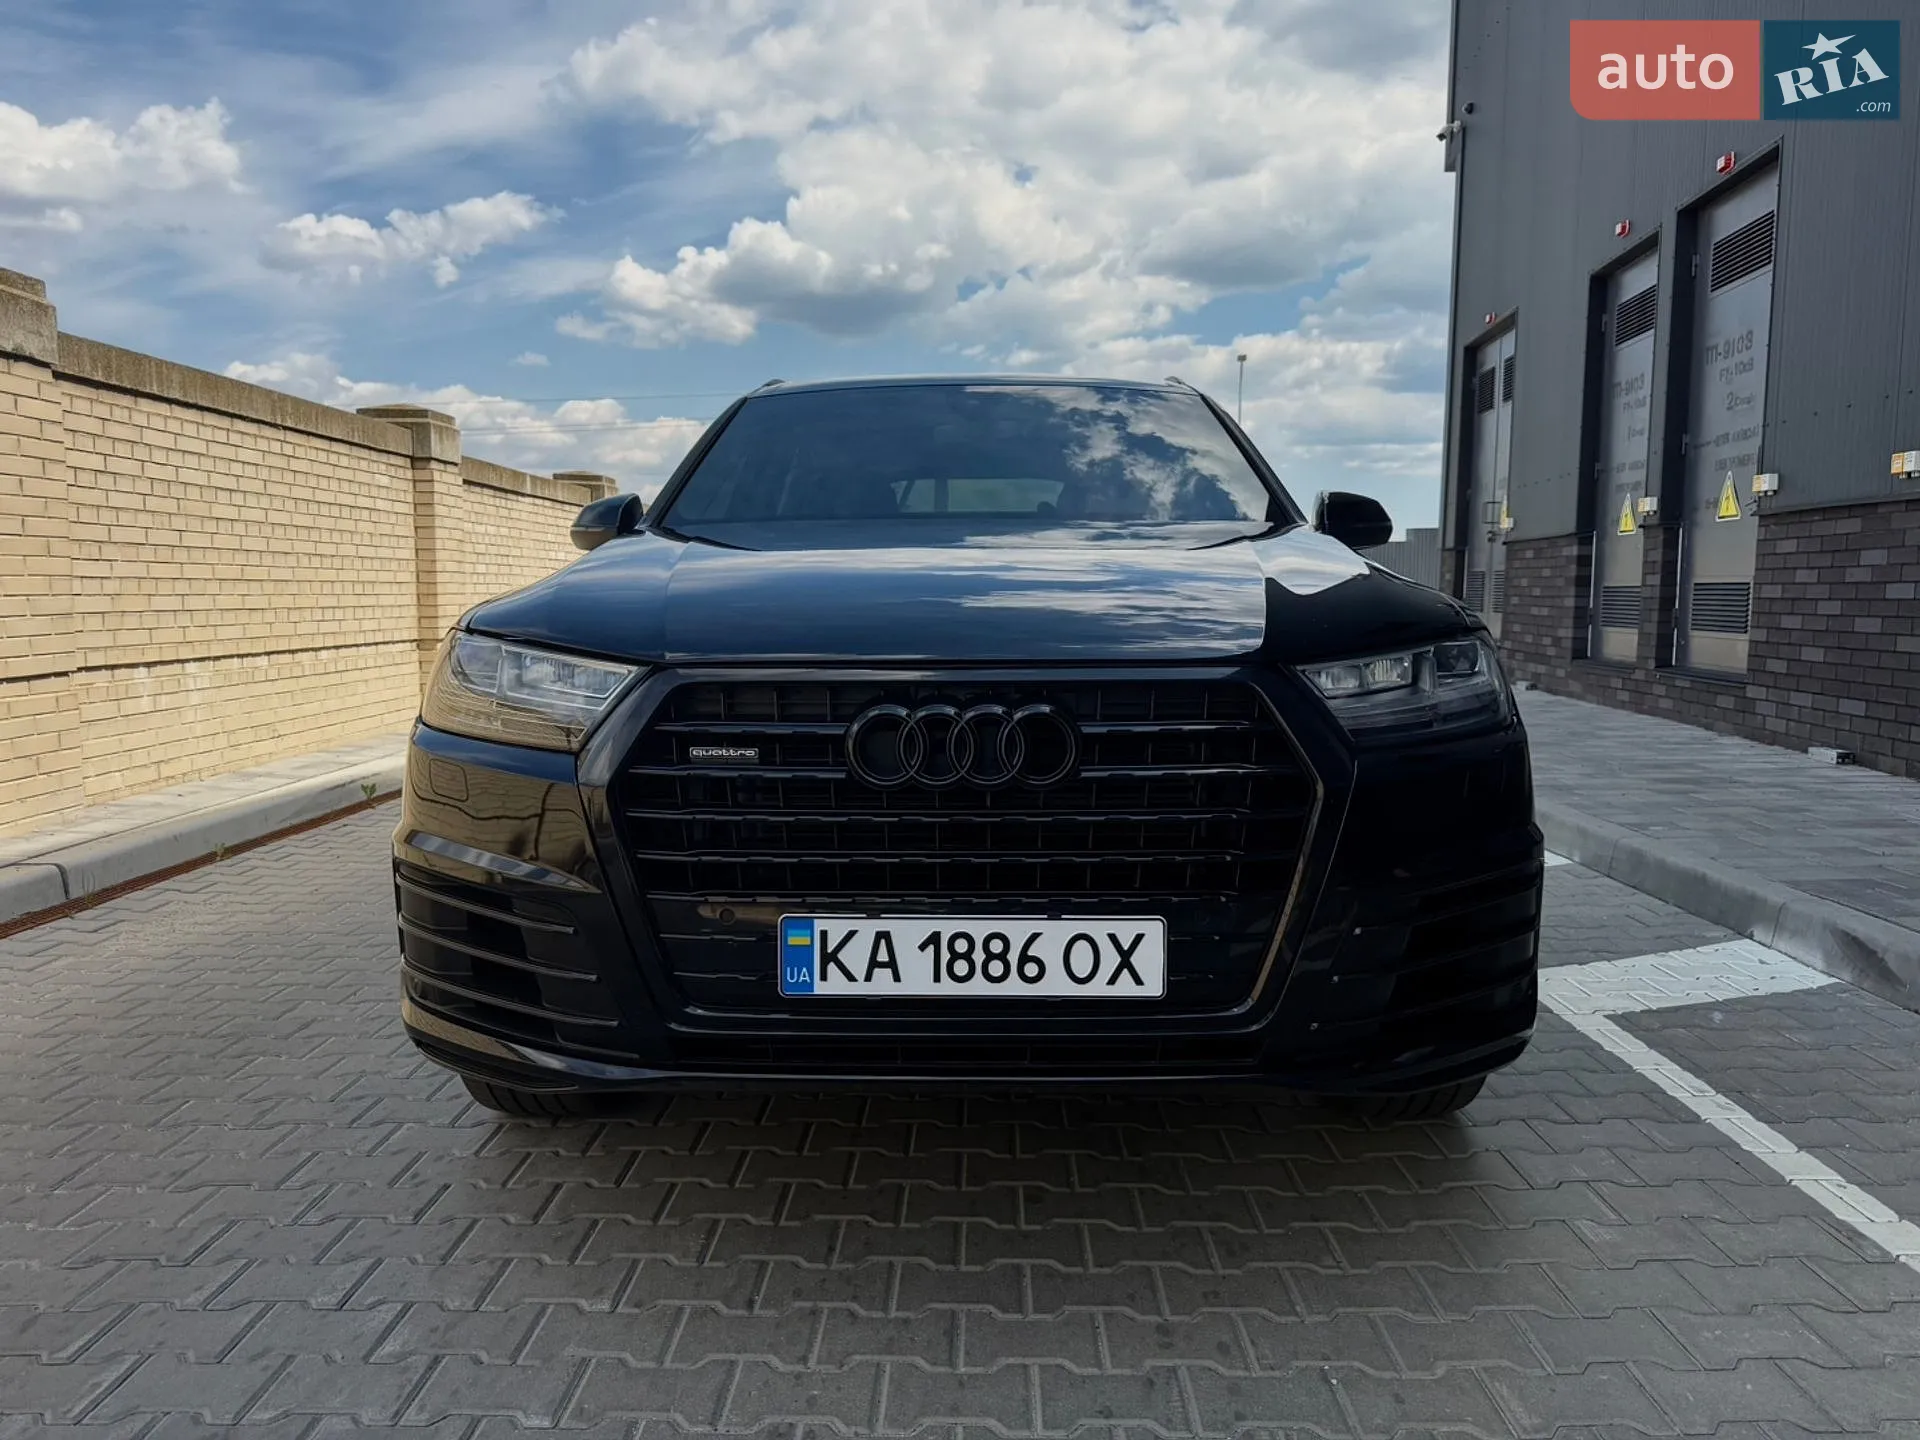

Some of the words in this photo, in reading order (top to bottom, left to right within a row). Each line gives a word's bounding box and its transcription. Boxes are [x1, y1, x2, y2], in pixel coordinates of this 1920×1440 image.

[692, 749, 756, 757] quattro
[818, 929, 902, 983] KA
[917, 930, 1047, 984] 1886
[1062, 931, 1146, 986] OX
[786, 967, 811, 983] UA
